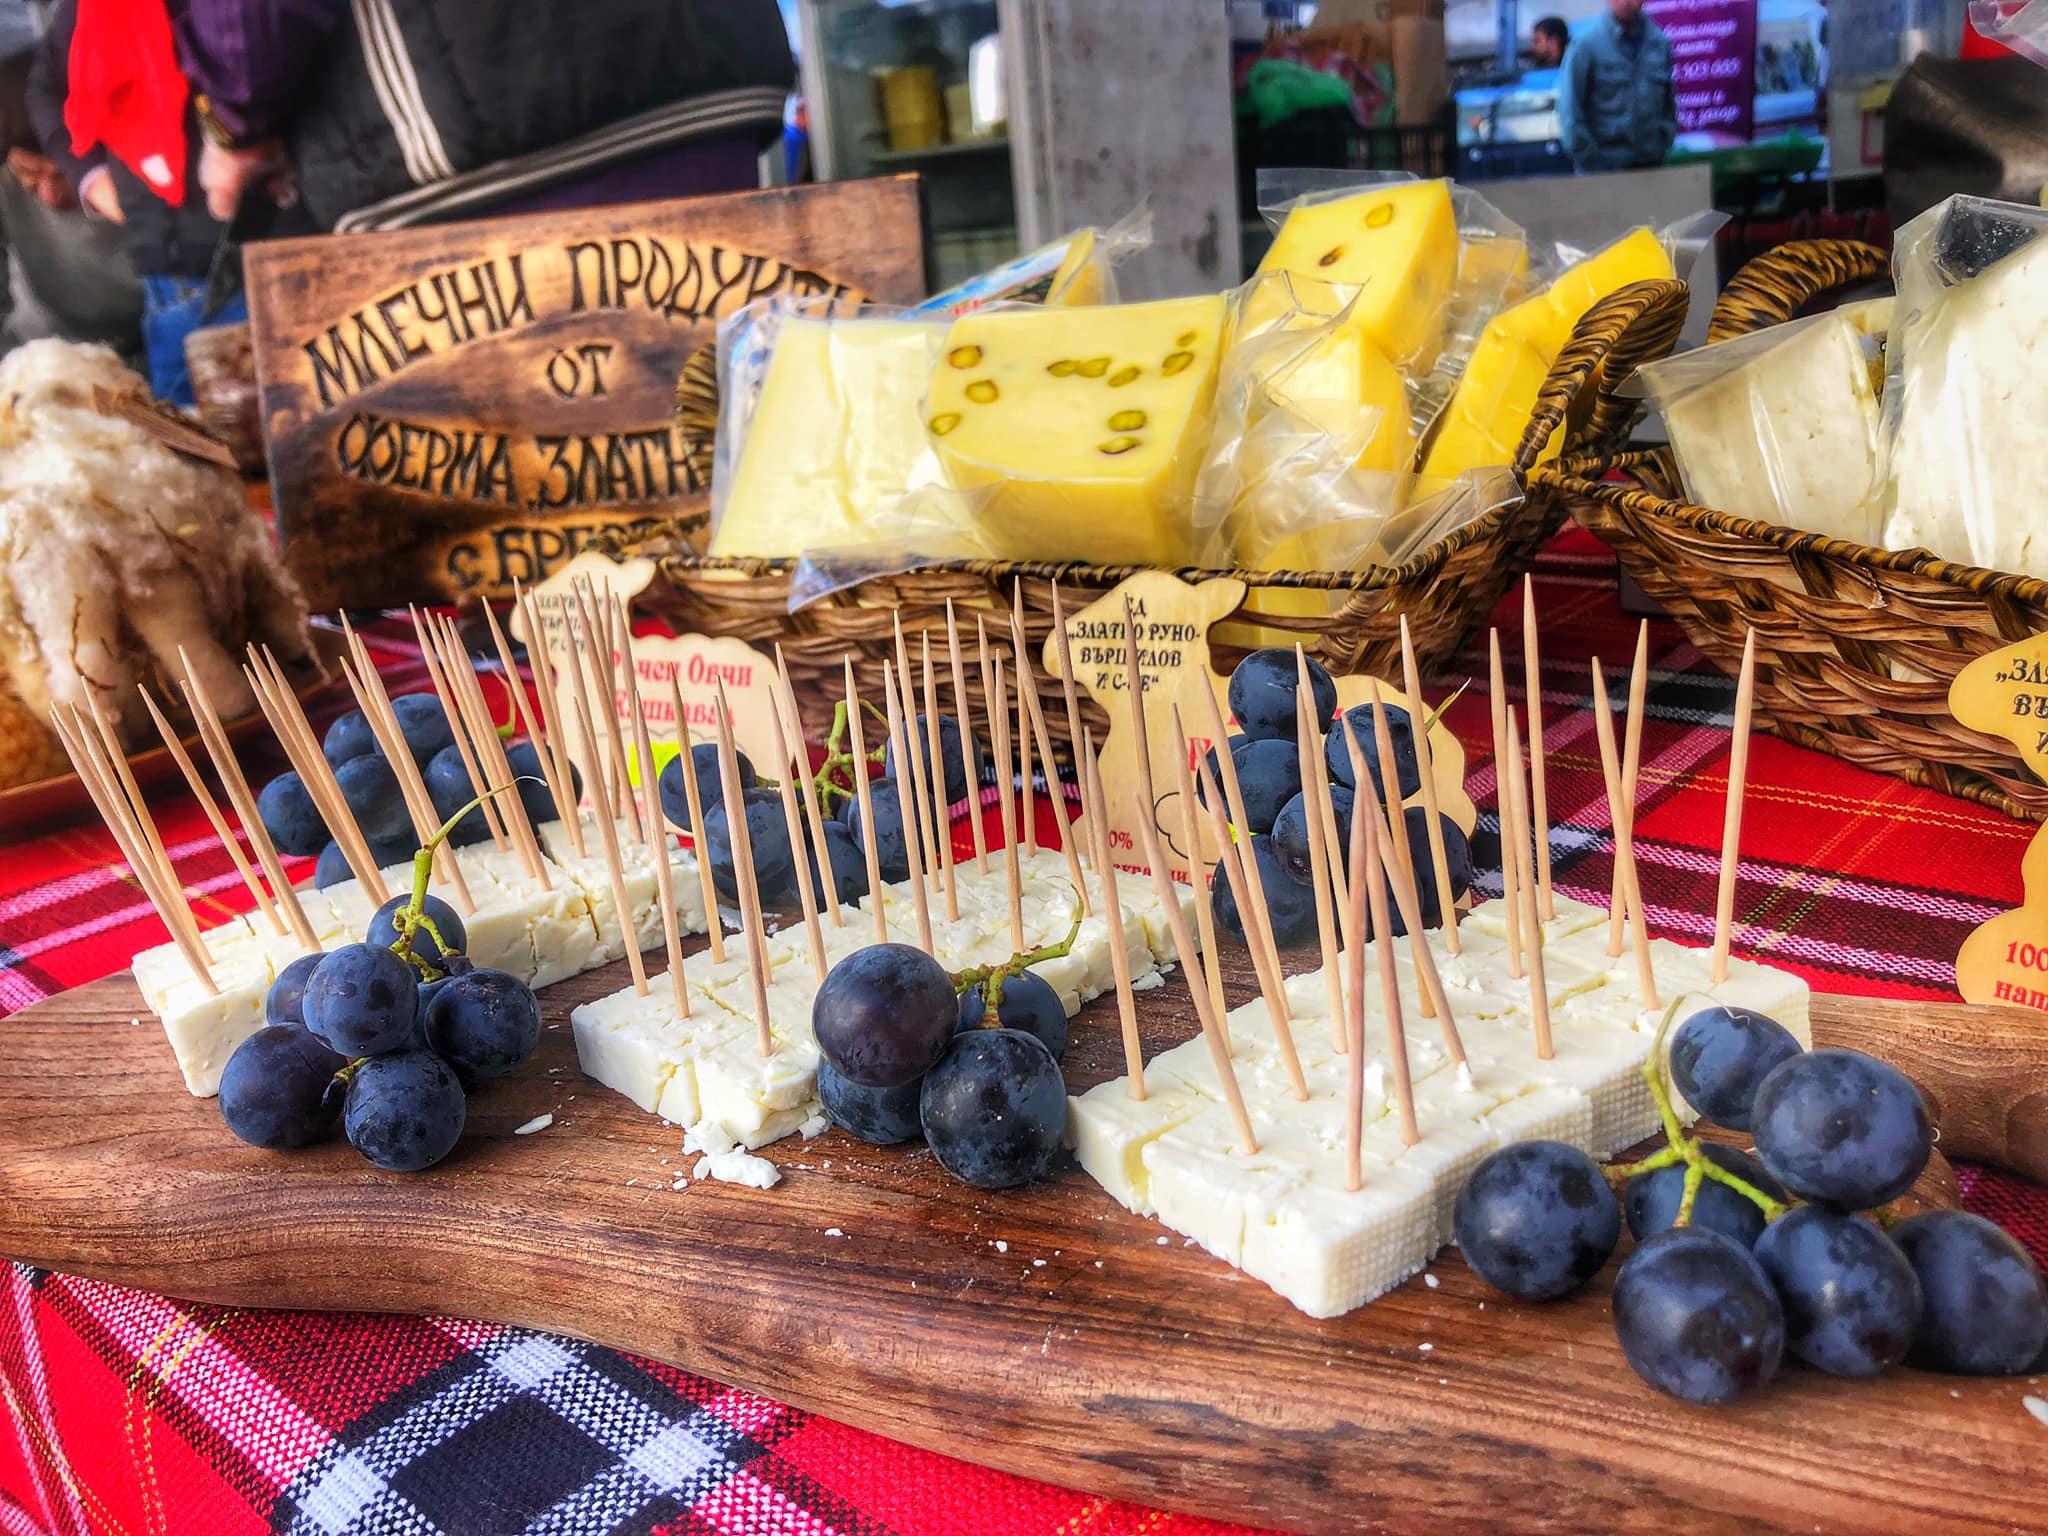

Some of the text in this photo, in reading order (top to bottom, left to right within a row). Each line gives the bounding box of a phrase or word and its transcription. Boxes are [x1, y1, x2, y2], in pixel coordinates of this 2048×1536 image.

[304, 254, 535, 408] МЛЕЧНИ
[547, 344, 616, 400] ОТ
[337, 411, 517, 502] ФЕРМА
[687, 653, 753, 687] Овчи
[1095, 671, 1159, 692] И С-Е“
